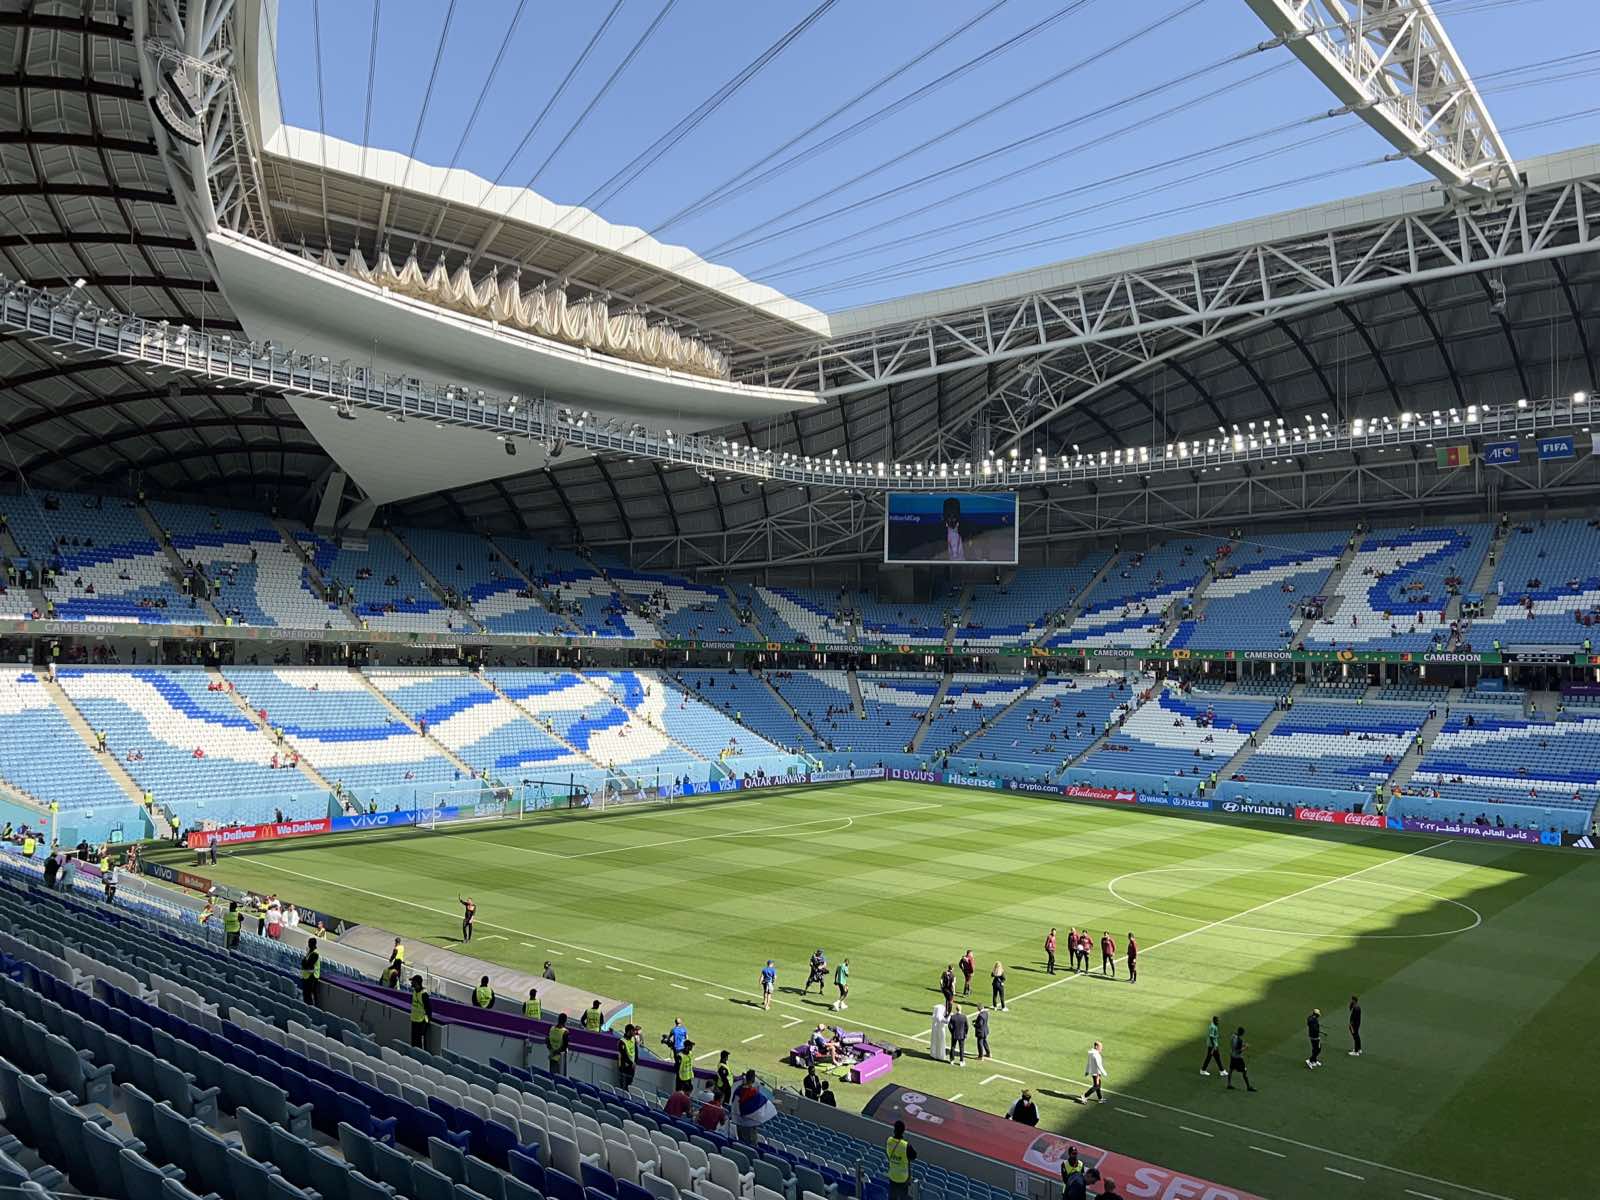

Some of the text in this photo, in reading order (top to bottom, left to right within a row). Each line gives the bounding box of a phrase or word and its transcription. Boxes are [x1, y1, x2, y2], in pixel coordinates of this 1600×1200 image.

[1488, 447, 1512, 459] AFC
[1543, 442, 1568, 452] FIFA
[45, 623, 114, 633] CAMEROON
[270, 630, 324, 639] CAMEROON
[701, 641, 735, 649] CAMEROON
[1244, 651, 1292, 659] CAMEROON
[1423, 653, 1481, 662] CAMEROON
[744, 774, 807, 788] QATAR AIRWAYS
[903, 769, 935, 782] BYJU'S
[948, 773, 996, 788] Hisense
[693, 782, 711, 793] VISA
[720, 779, 736, 791] VISA
[1019, 782, 1058, 793] crypto.com
[1068, 786, 1112, 800] Budweiser
[1147, 796, 1168, 804] WANDA
[406, 809, 441, 821] vivo
[1241, 804, 1285, 816] HYUNDAI
[350, 815, 388, 827] vivo
[277, 822, 324, 835] We Deliver
[223, 830, 256, 841] Deliver
[153, 865, 172, 880] vivo
[299, 908, 316, 925] VISA
